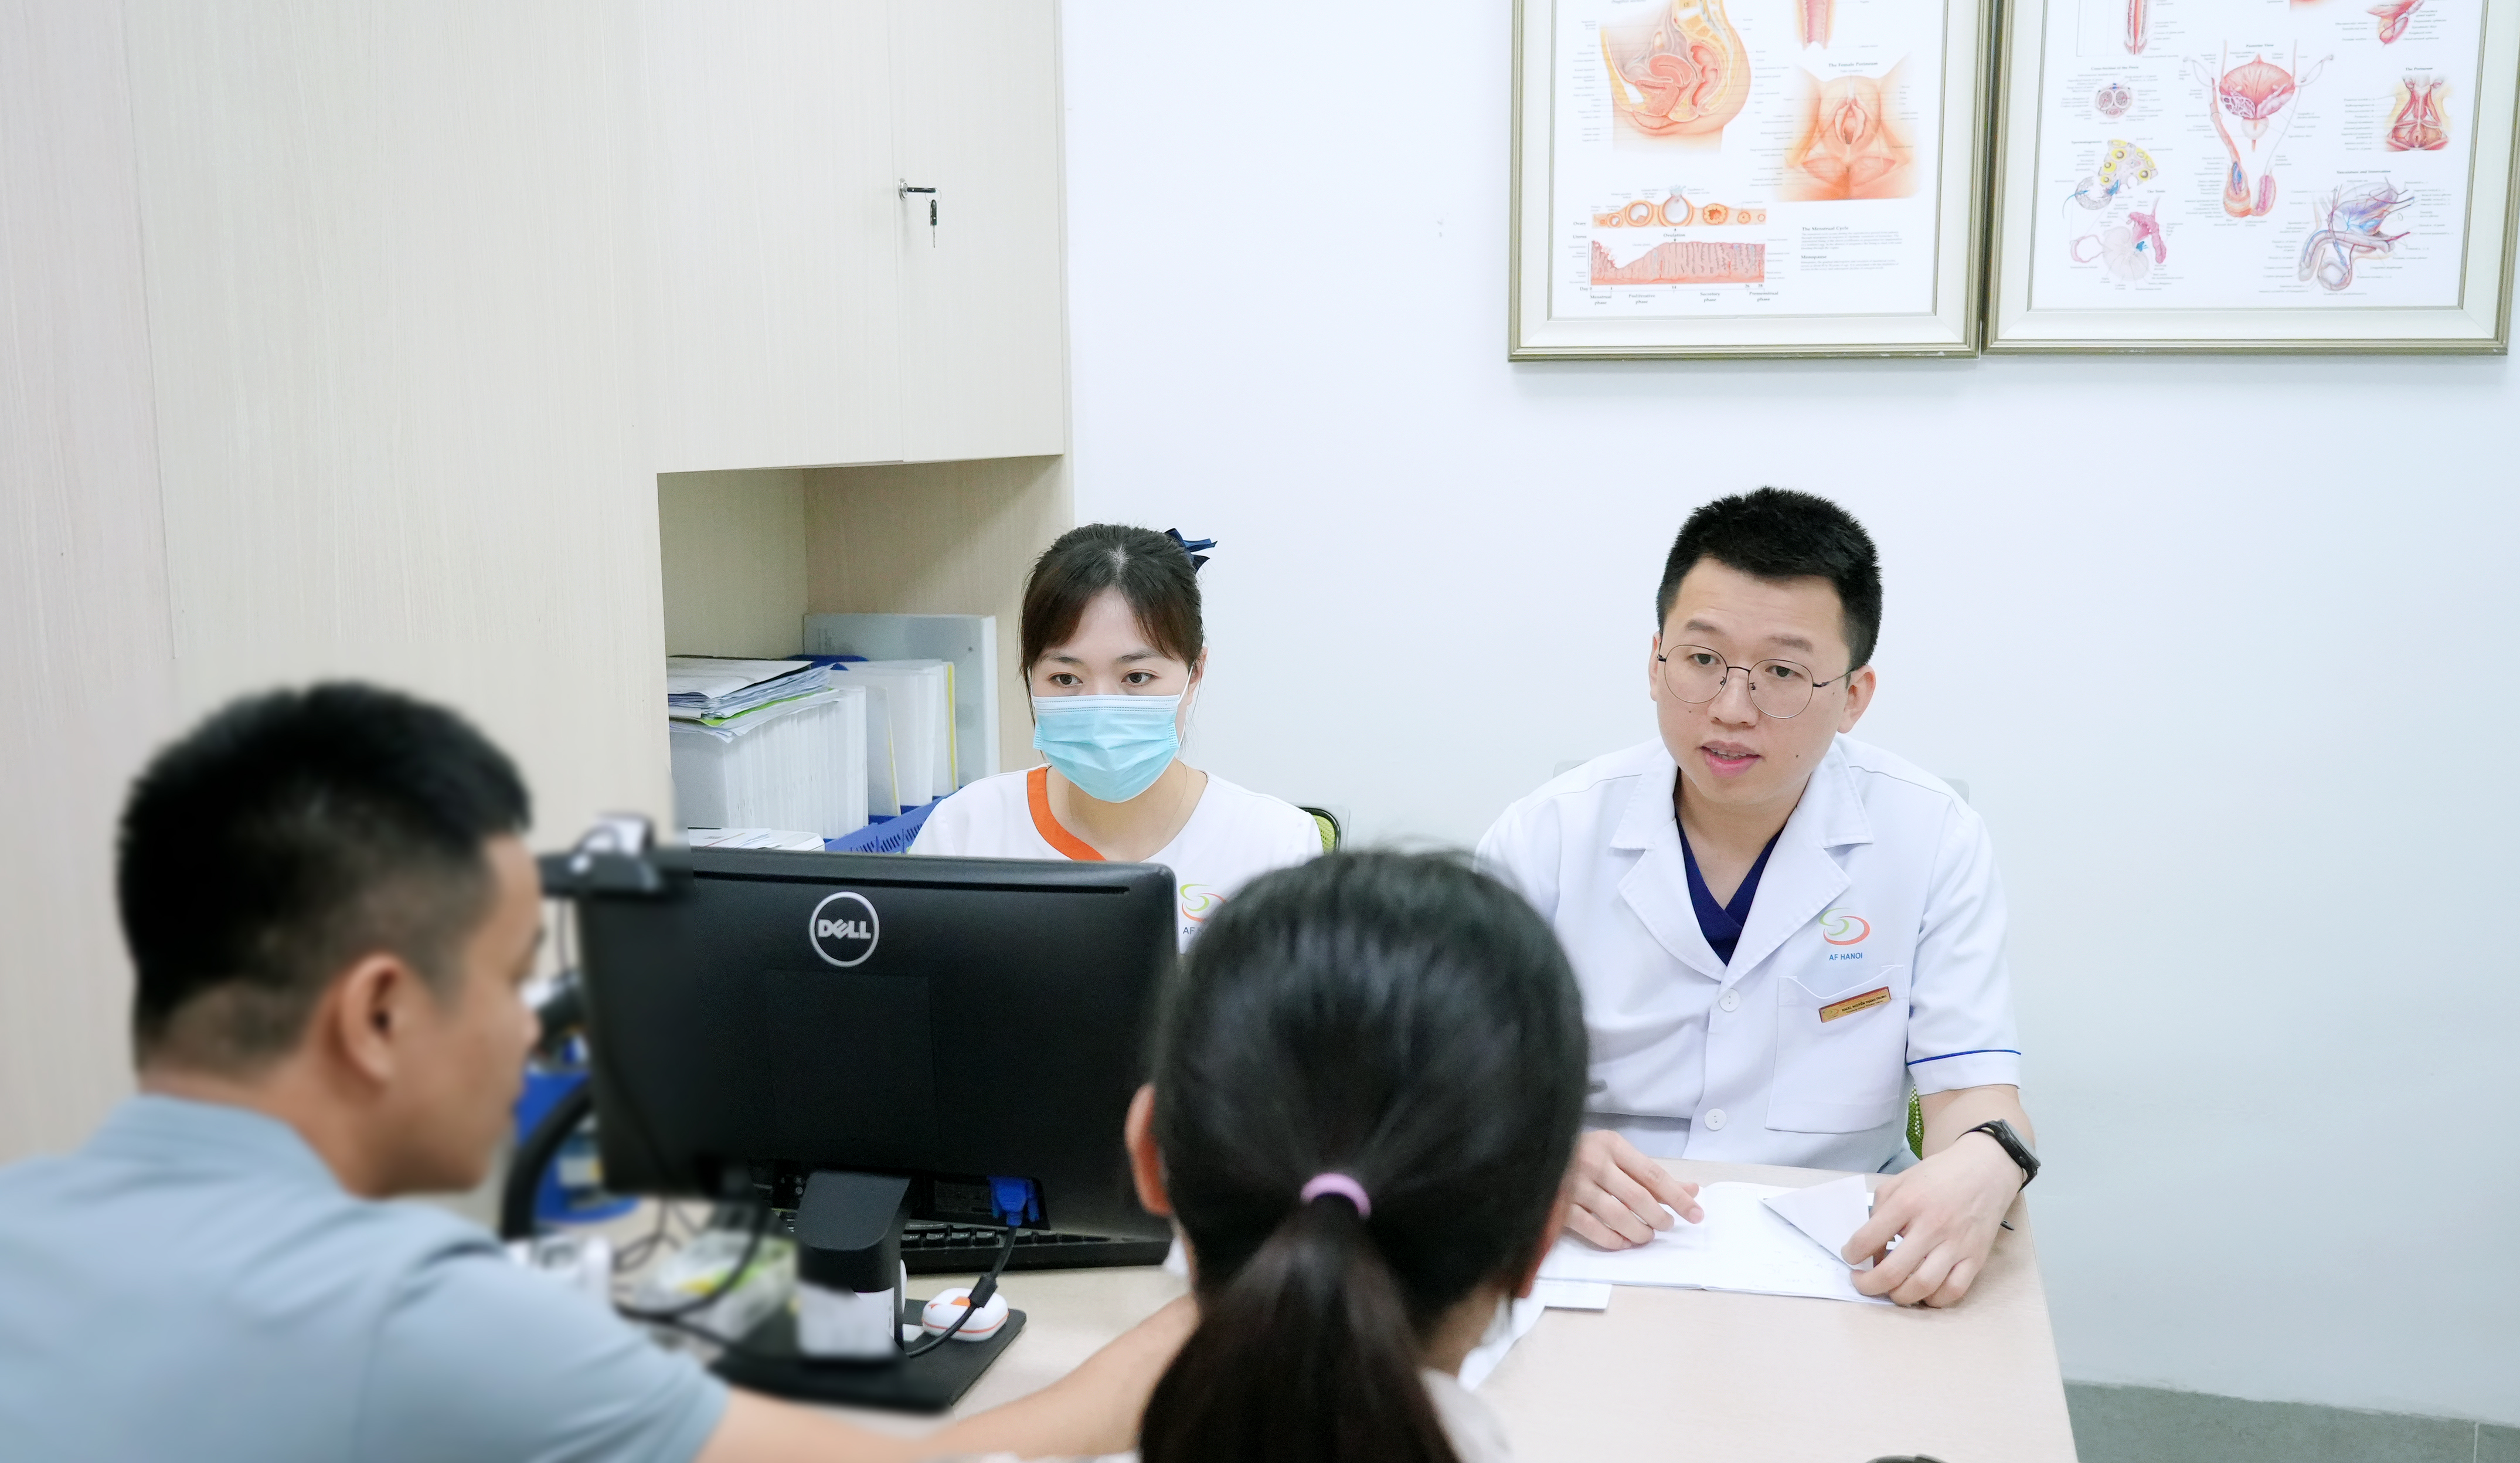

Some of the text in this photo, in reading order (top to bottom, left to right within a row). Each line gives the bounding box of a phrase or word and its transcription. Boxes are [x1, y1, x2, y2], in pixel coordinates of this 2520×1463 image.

[817, 918, 872, 939] DELL
[1182, 926, 1195, 935] AF
[1841, 952, 1863, 960] HANOI
